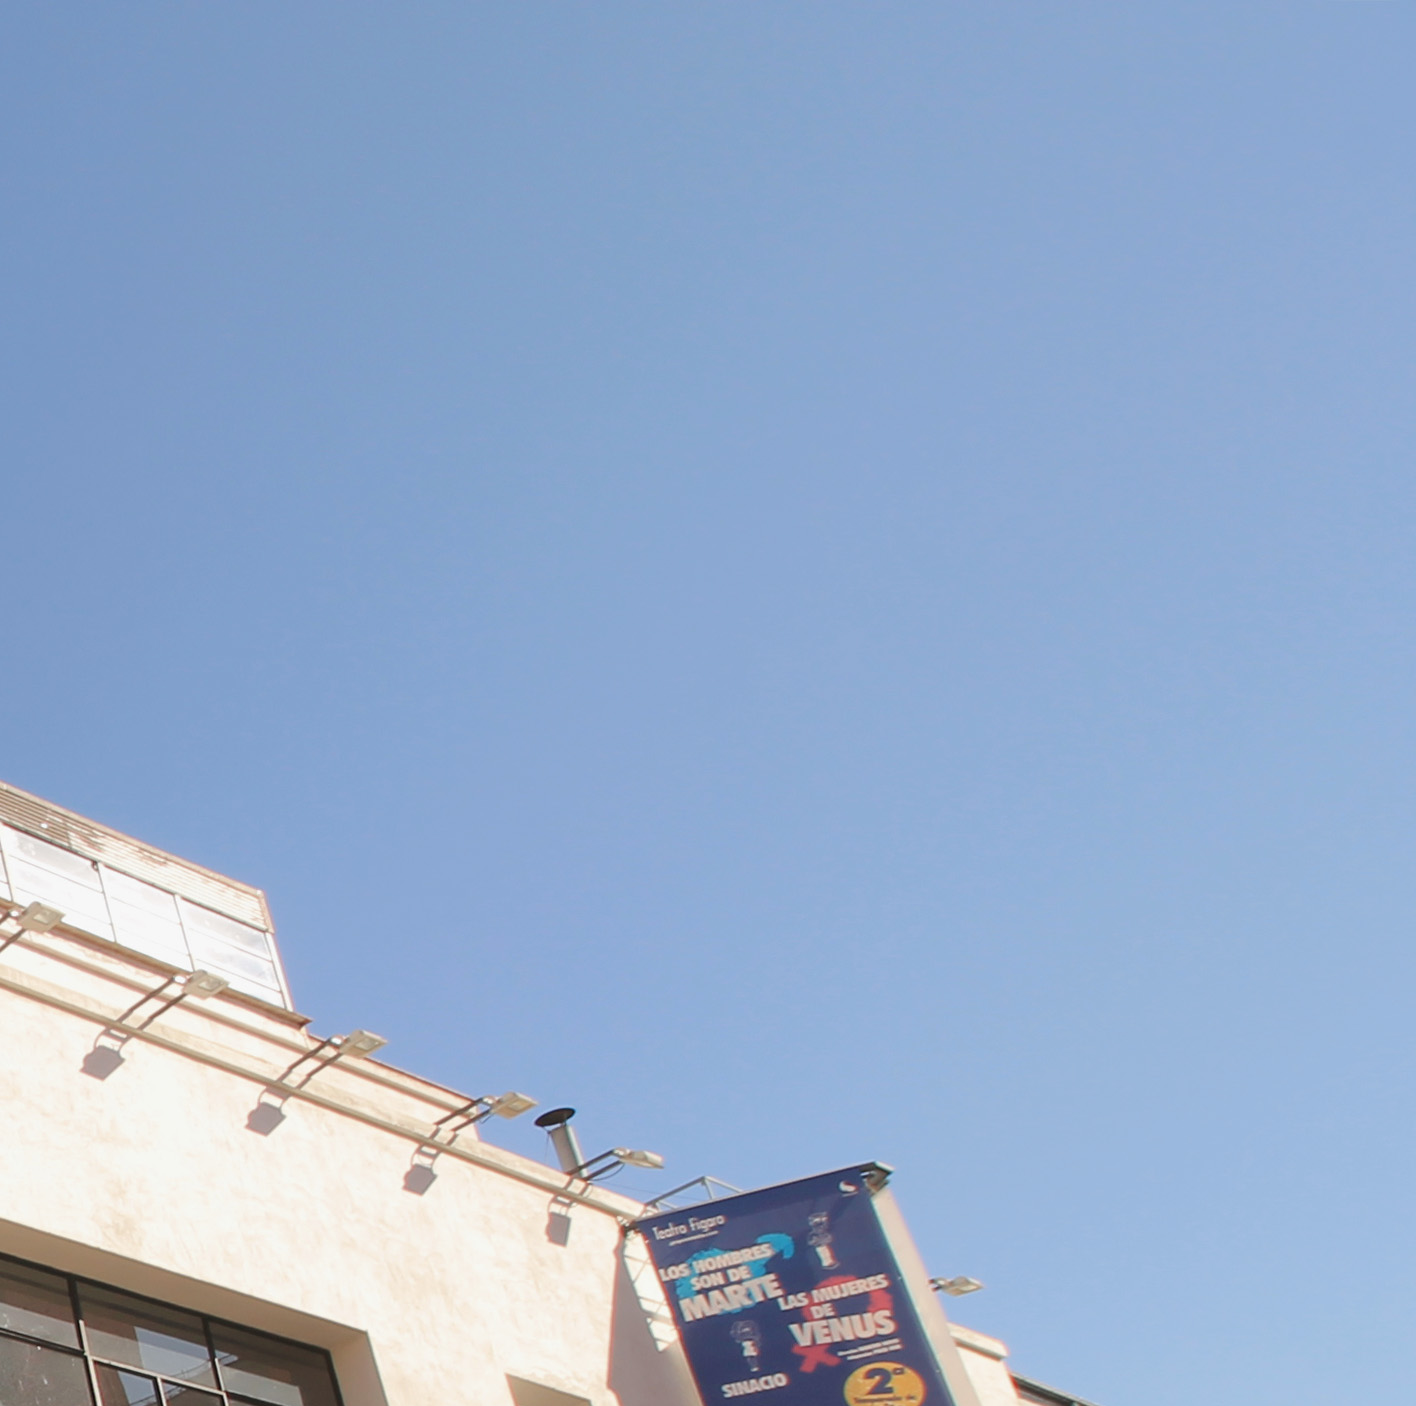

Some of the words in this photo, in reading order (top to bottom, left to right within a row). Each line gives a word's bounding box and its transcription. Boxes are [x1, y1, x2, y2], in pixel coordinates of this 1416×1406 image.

[652, 1222, 687, 1240] Teatro
[688, 1214, 726, 1233] Figaro
[658, 1262, 691, 1282] LOS
[692, 1243, 776, 1273] HOMBRES
[690, 1271, 726, 1291] SON
[726, 1265, 752, 1282] DE
[678, 1273, 786, 1322] MARTE
[777, 1291, 809, 1311] LAS
[810, 1273, 890, 1303] MUJERES
[810, 1302, 835, 1319] DE
[788, 1310, 898, 1347] VENUS
[721, 1372, 790, 1400] SINACIO
